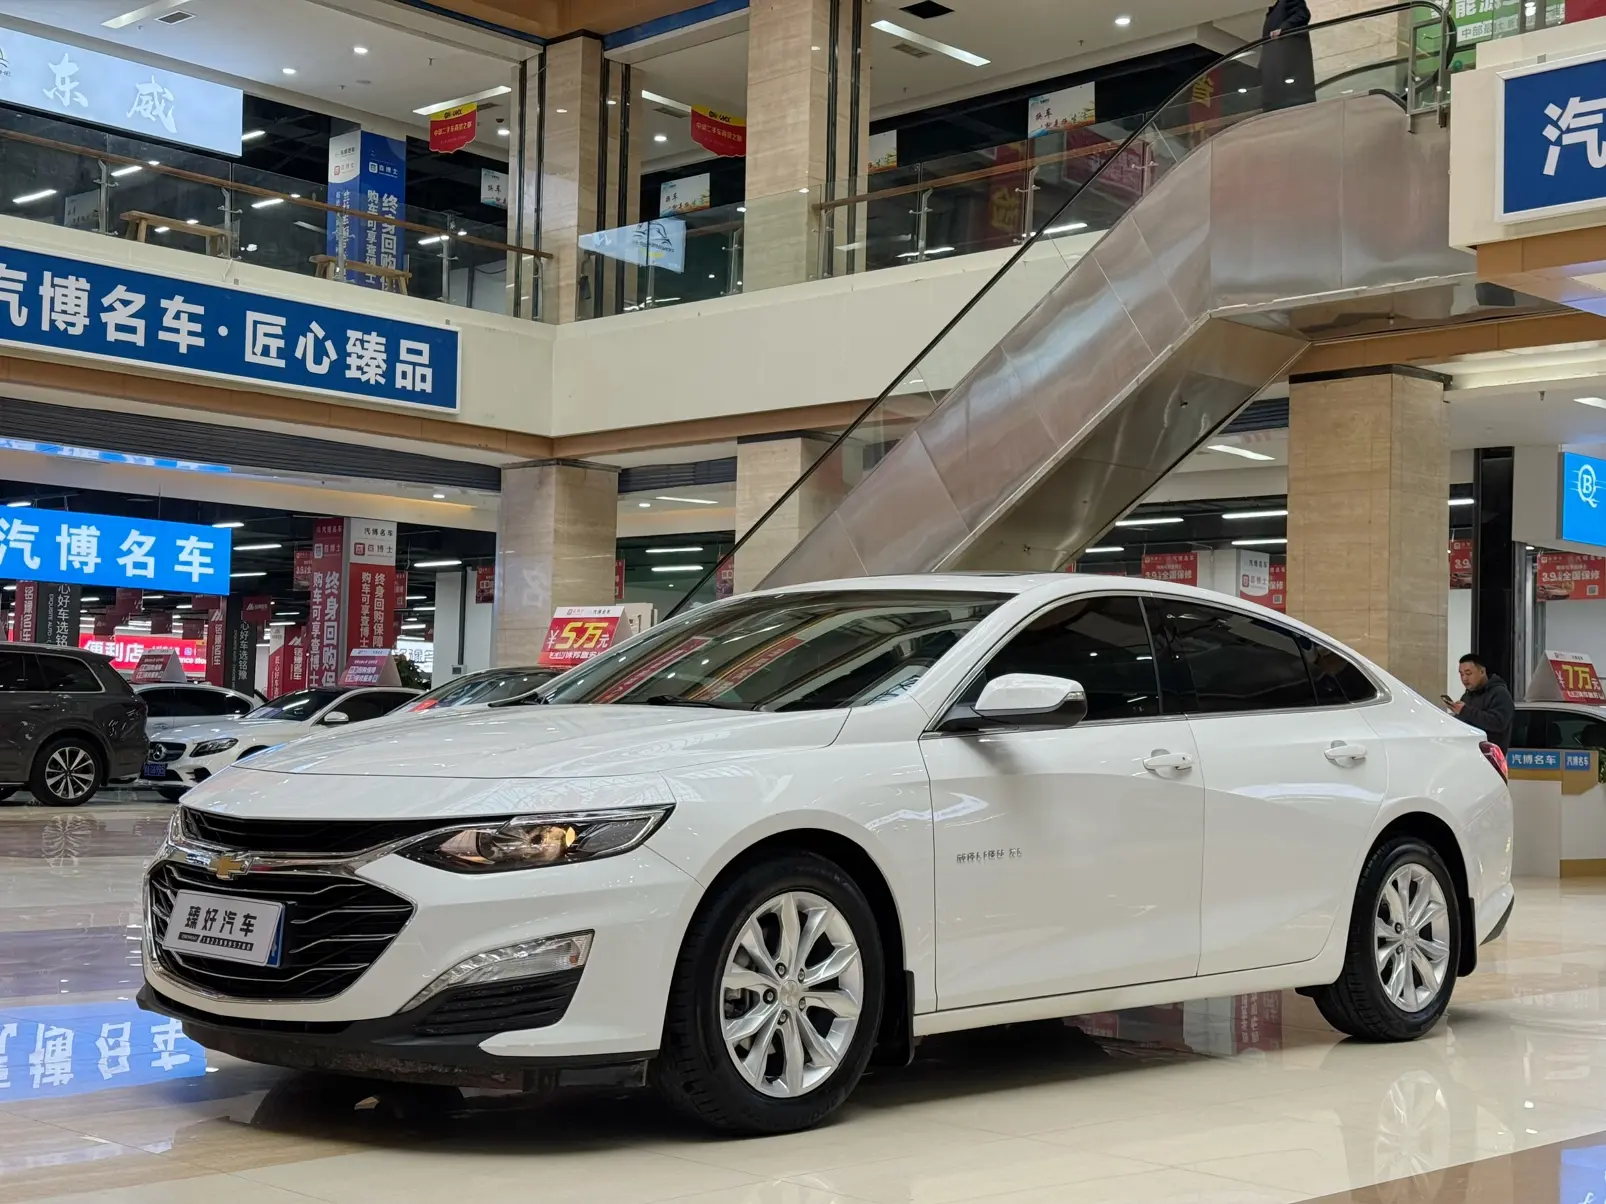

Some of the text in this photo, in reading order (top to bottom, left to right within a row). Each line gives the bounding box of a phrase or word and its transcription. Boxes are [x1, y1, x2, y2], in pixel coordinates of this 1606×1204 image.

[42, 53, 178, 134] 东威
[1542, 96, 1606, 177] 汽
[364, 527, 393, 538] 汽博名车
[0, 518, 215, 583] 汽博名车
[373, 572, 386, 648] 终身回购保障
[84, 640, 145, 663] 便利店
[1512, 754, 1557, 765] 汽博名车
[1567, 755, 1589, 766] 汽博名车
[184, 905, 257, 937] 臻好汽车
